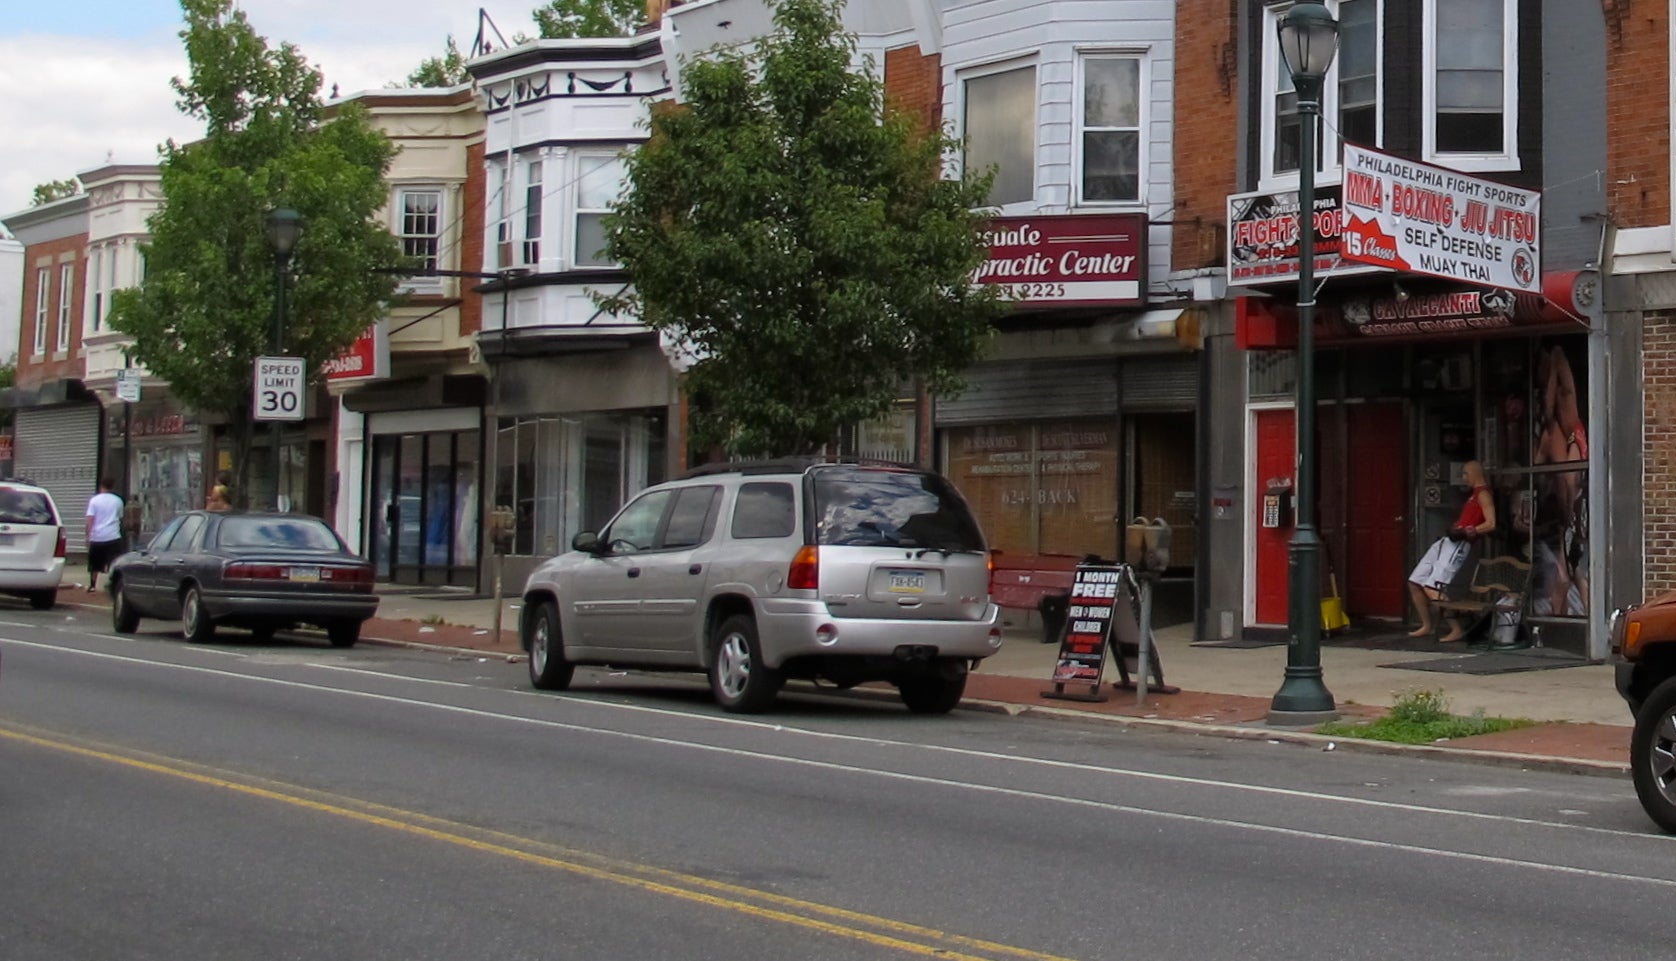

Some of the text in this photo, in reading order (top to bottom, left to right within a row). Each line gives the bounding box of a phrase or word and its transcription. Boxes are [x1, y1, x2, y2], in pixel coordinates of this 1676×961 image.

[1357, 154, 1527, 207] PHILADELPHIA FIGHT SPORTS
[1346, 171, 1537, 245] MMA BOXING JIU JITSU
[1236, 217, 1293, 248] FIGHT
[1404, 227, 1503, 262] SELF DEFENSE
[1059, 249, 1136, 276] Center
[1419, 253, 1491, 282] MUAY THAI
[261, 364, 300, 375] SPEED
[264, 378, 295, 387] LIMIT
[262, 390, 298, 412] 30
[1072, 583, 1117, 598] FREE
[1076, 572, 1120, 583] 1 MONTH
